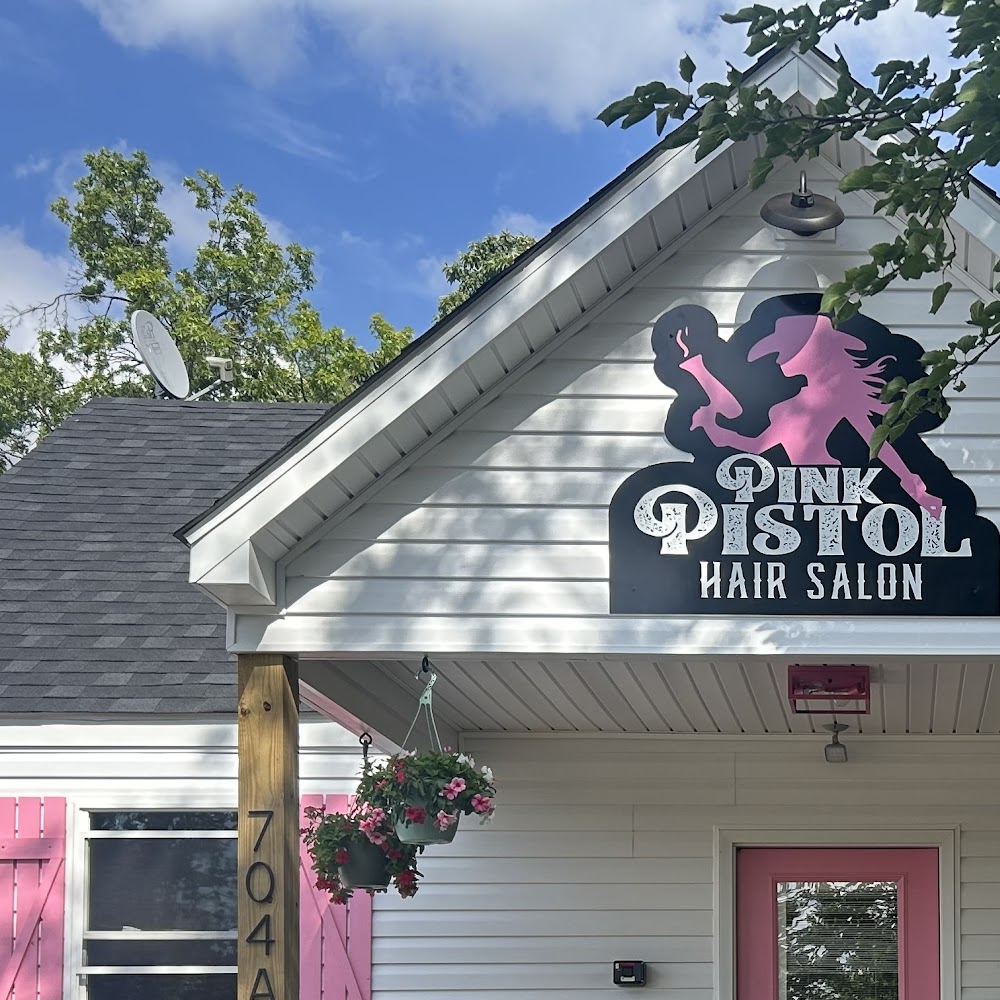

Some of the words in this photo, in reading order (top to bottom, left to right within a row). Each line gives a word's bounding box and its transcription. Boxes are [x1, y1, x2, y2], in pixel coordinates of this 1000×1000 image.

[716, 453, 883, 504] PINK
[633, 484, 972, 557] PISTOL
[699, 560, 788, 599] HAIR
[806, 562, 924, 601] SALON
